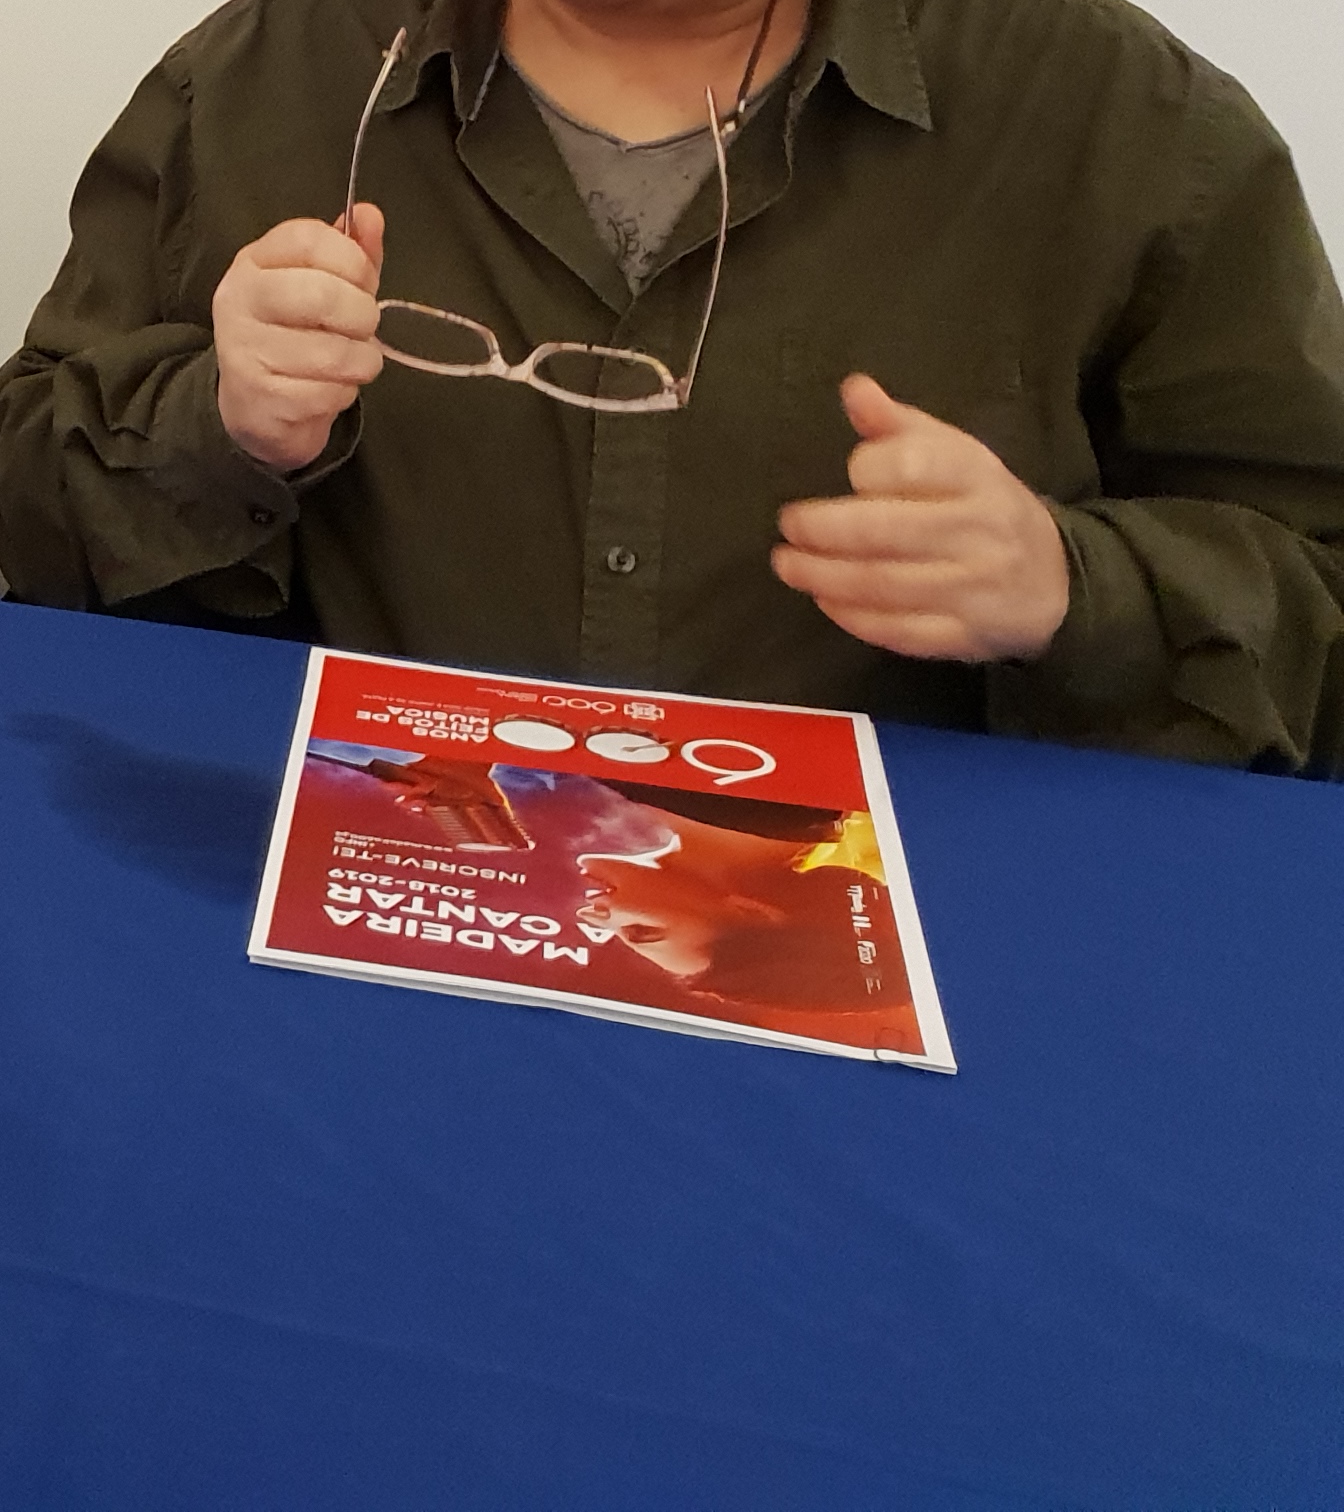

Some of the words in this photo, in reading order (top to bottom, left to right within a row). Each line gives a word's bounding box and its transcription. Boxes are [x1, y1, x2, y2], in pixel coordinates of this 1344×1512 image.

[356, 709, 391, 723] DE
[328, 867, 477, 899] 2018-2019
[326, 882, 562, 935] CANTAR
[322, 904, 589, 966] MADEIRA
[576, 922, 615, 943] A
